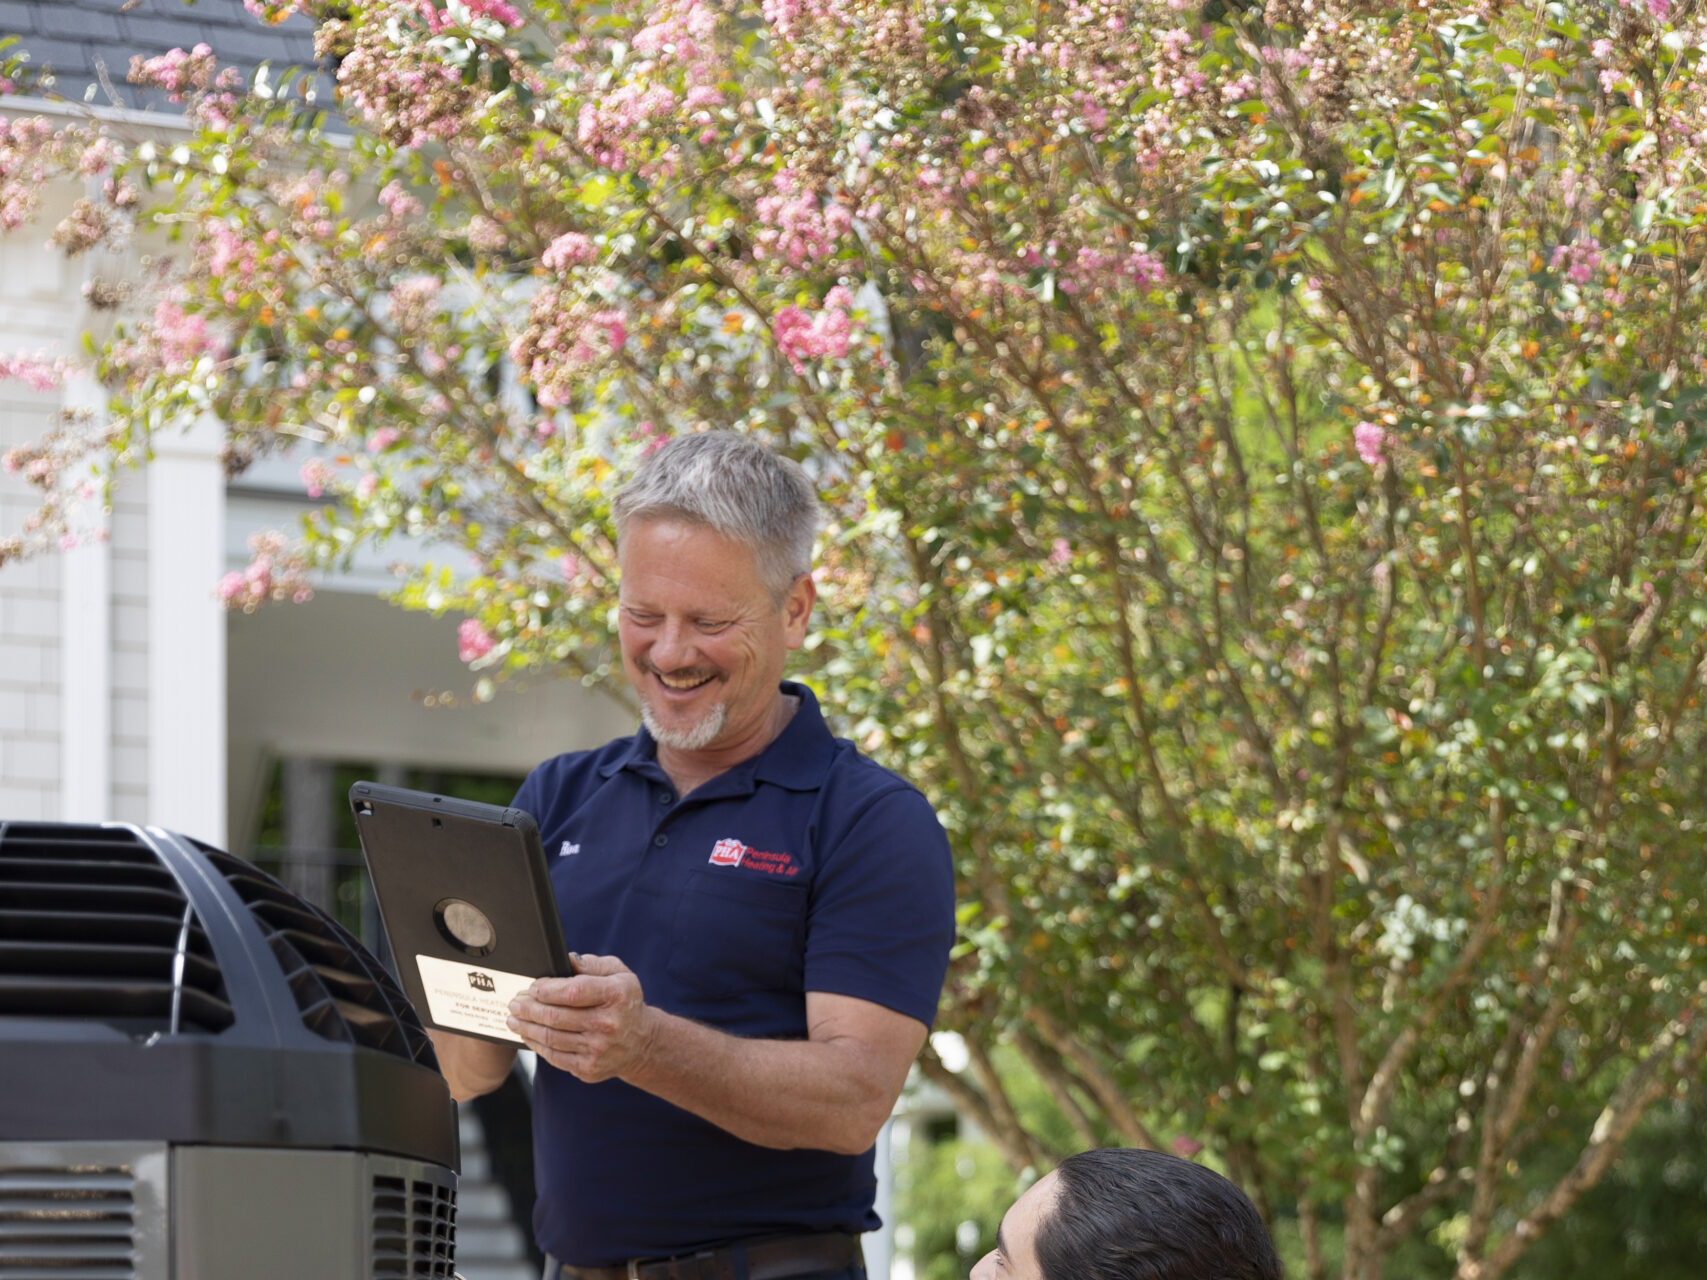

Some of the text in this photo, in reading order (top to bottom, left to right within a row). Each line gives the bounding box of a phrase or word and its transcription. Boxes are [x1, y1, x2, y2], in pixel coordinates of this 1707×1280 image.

[714, 846, 739, 860] PHA
[745, 847, 791, 864] Peninsula
[741, 857, 776, 874] Heating
[776, 863, 784, 874] &
[470, 976, 494, 988] PHA
